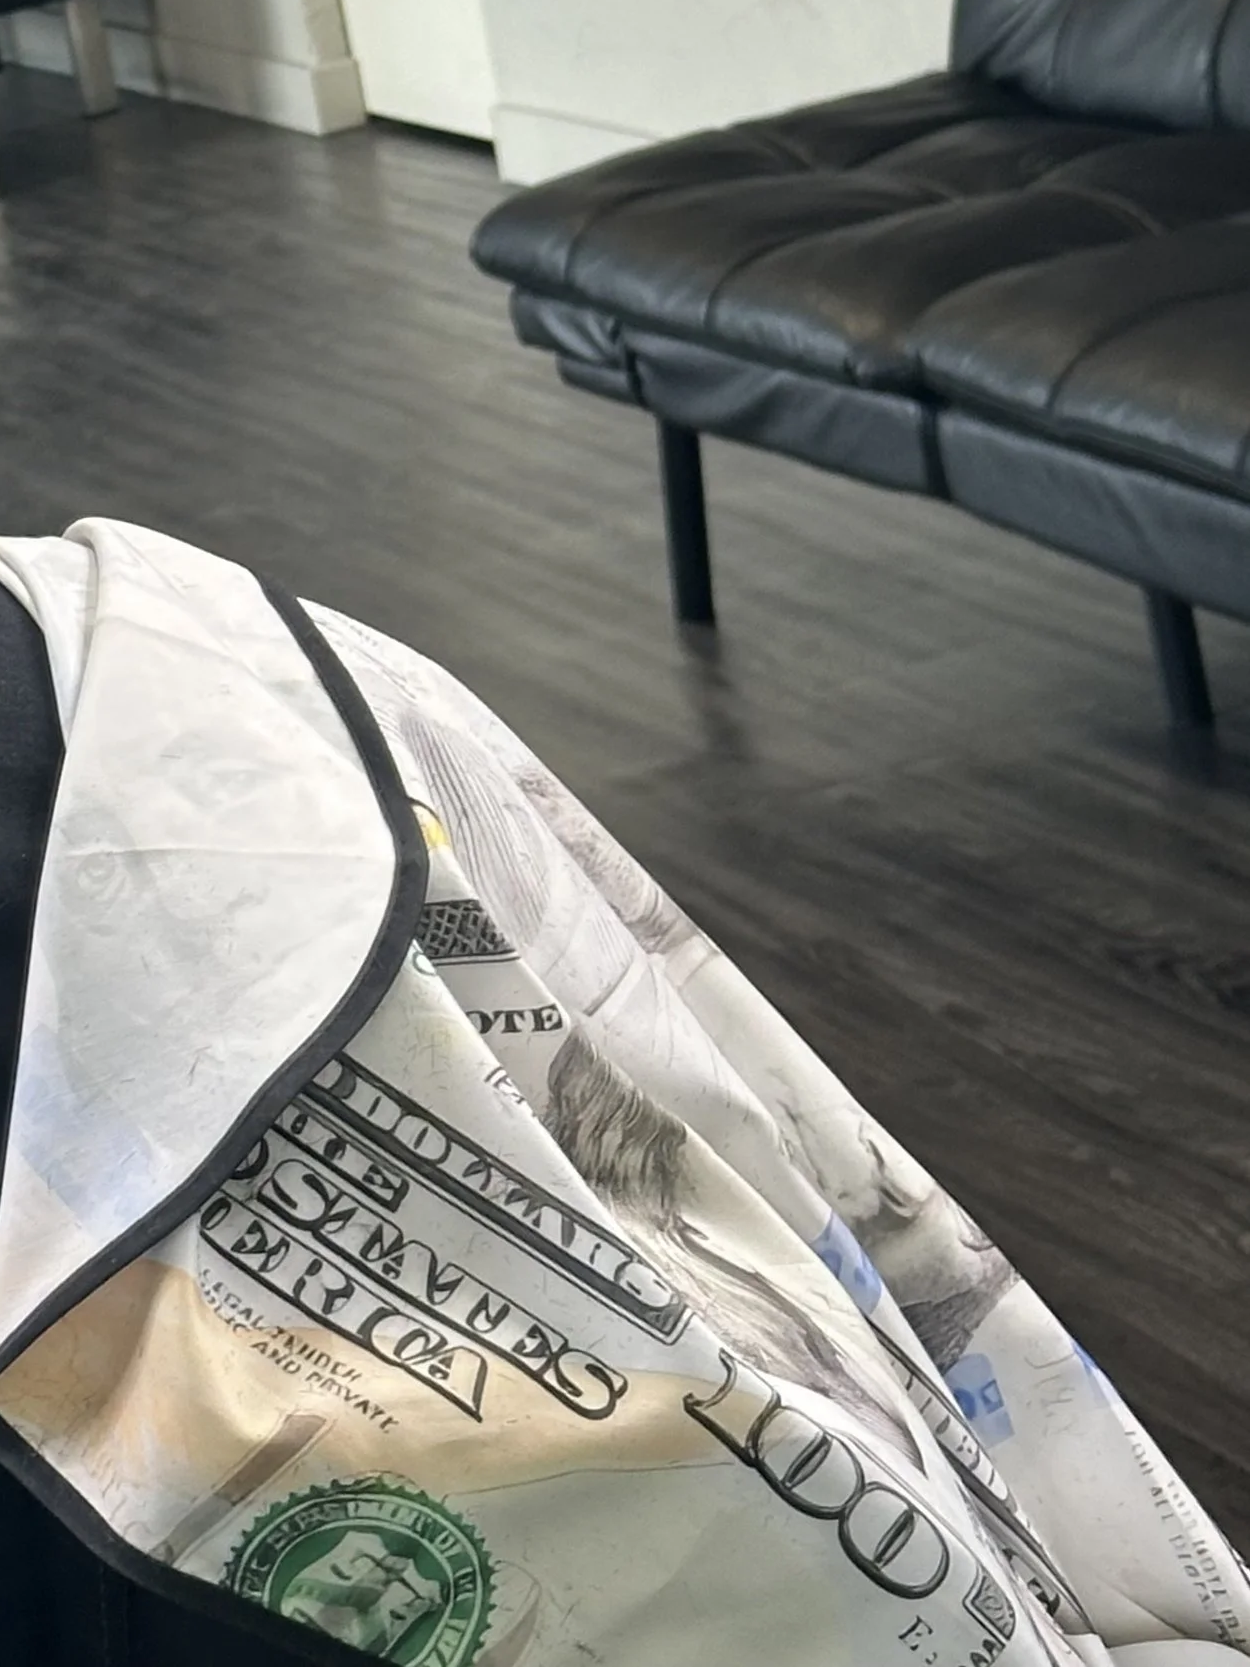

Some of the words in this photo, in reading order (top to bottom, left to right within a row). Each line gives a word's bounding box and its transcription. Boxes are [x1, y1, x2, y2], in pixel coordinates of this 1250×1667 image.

[466, 1002, 563, 1034] OTE
[198, 1190, 485, 1422] ERICA
[257, 1156, 629, 1421] STATES
[340, 1076, 682, 1310] DOLLARS
[249, 1339, 303, 1375] AND
[682, 1346, 951, 1601] 100
